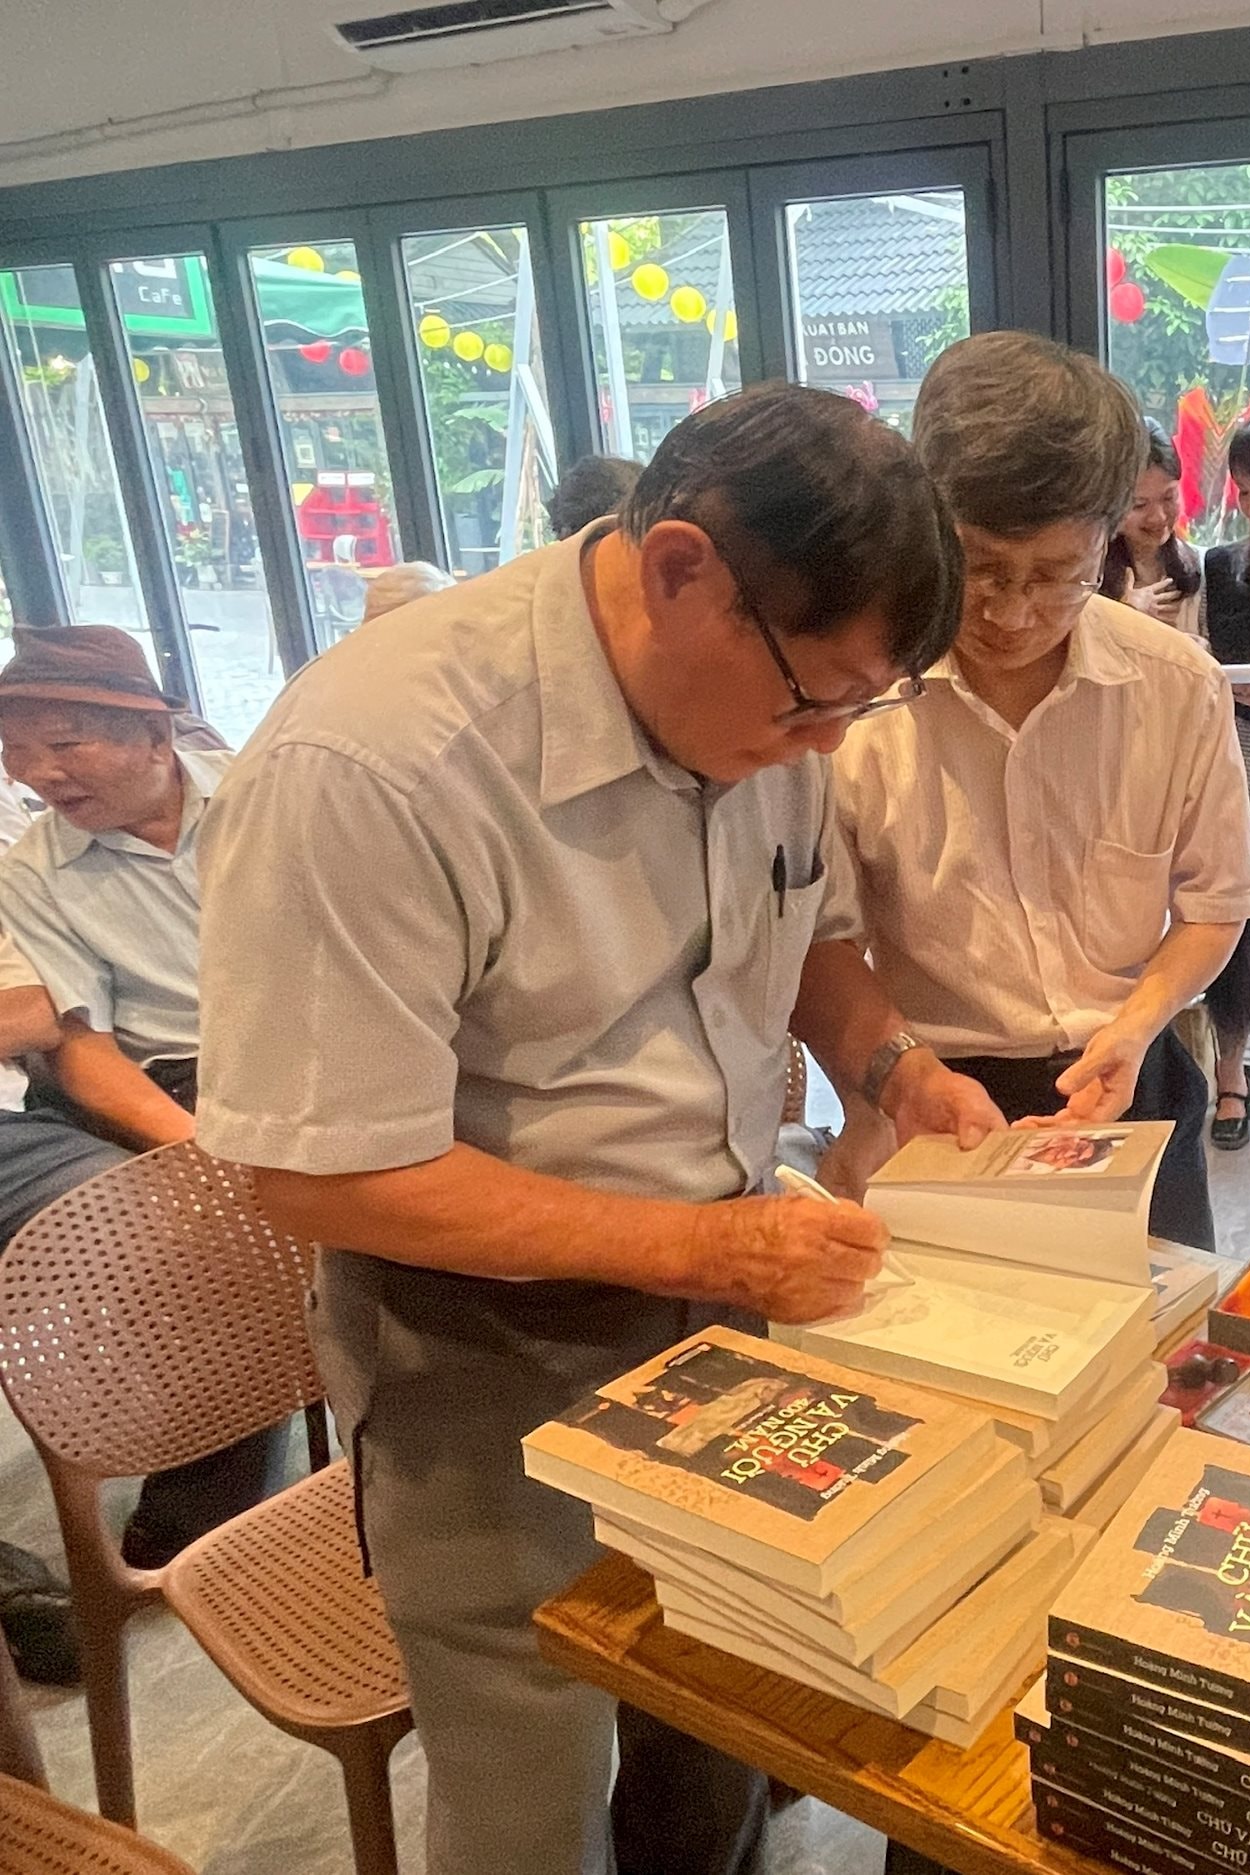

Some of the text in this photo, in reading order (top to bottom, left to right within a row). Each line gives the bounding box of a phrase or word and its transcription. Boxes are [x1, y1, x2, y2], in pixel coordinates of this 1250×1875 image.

[778, 1397, 810, 1418] 400
[787, 1421, 850, 1469] CHỮ
[1164, 1517, 1190, 1546] Minh
[1134, 1656, 1167, 1677] Hoàng
[1169, 1667, 1198, 1686] Minh
[1167, 1704, 1196, 1723] Minh
